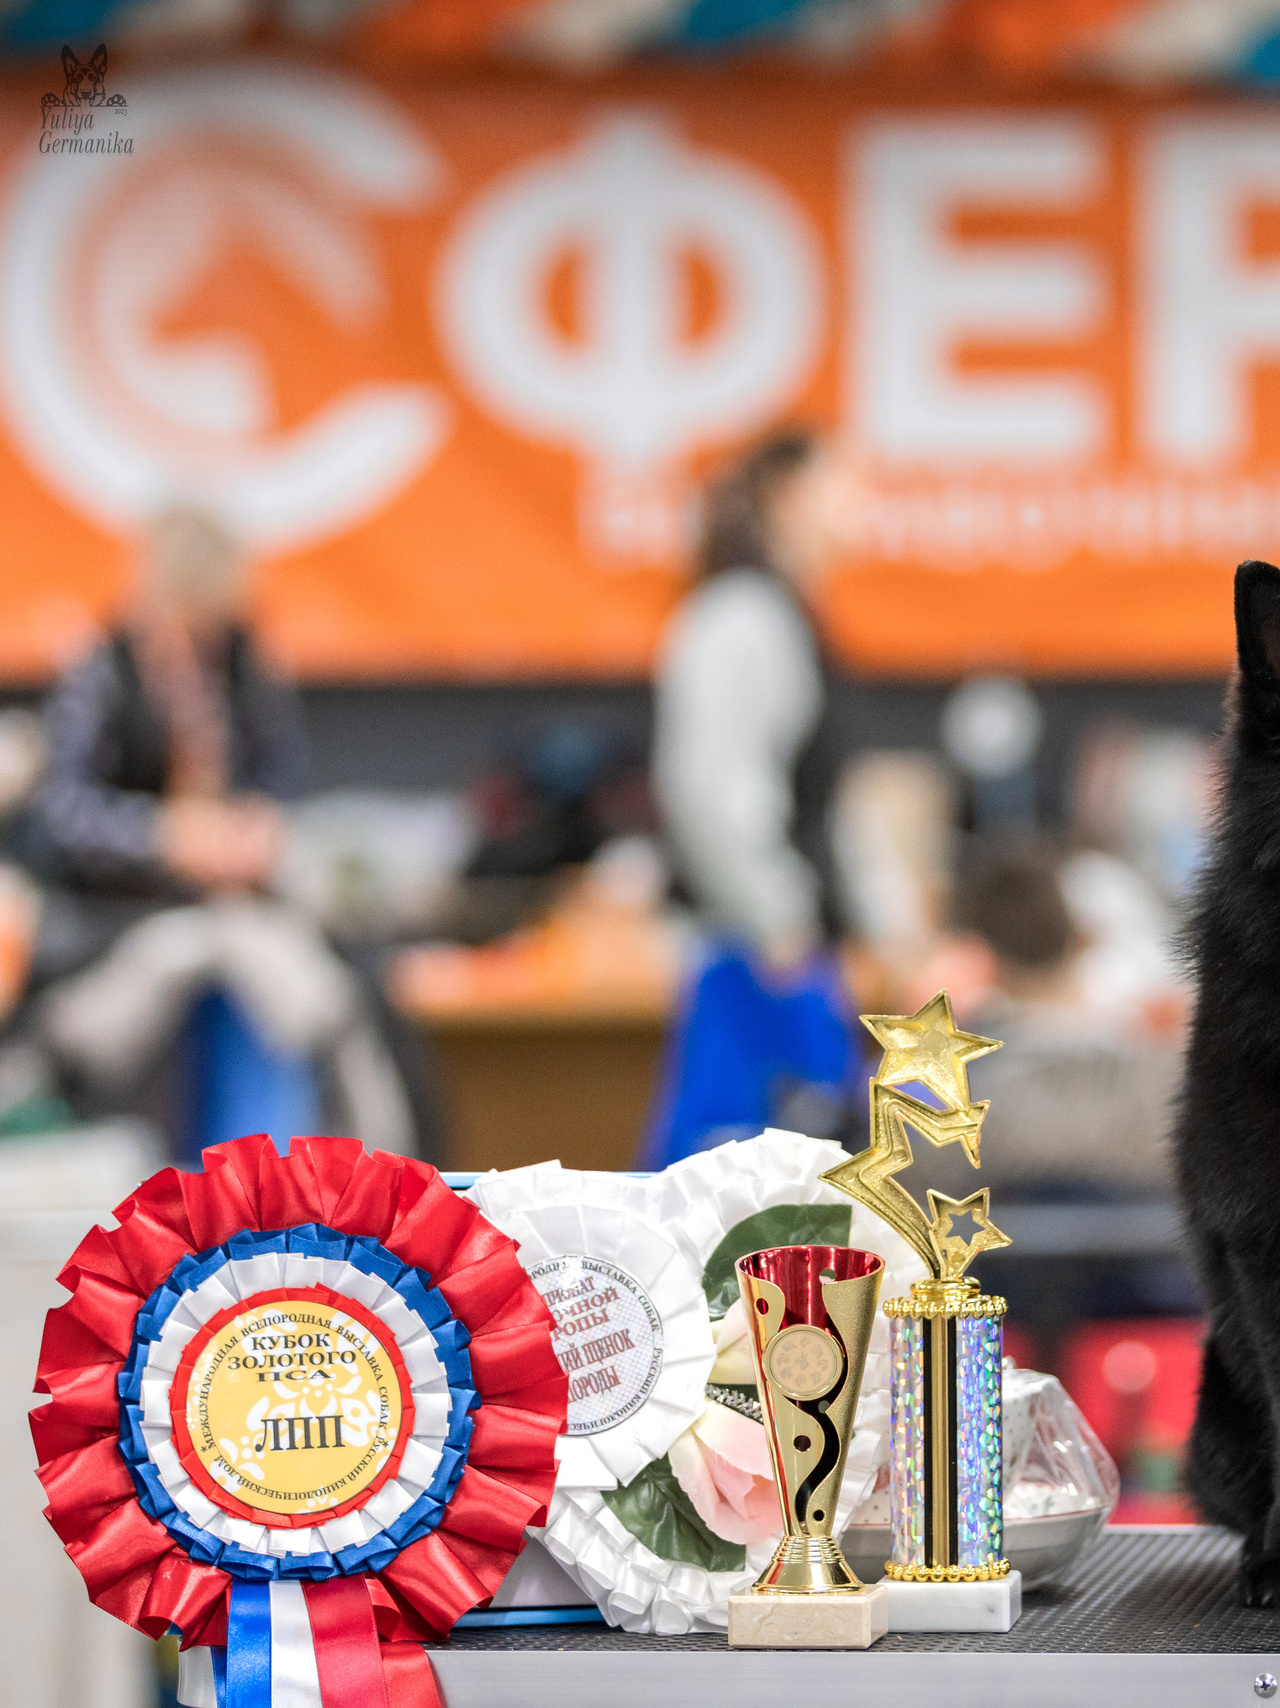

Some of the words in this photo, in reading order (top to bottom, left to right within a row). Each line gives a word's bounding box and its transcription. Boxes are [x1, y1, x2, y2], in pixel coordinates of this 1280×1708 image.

[581, 1260, 637, 1293] ВЫСТАВКА
[638, 1295, 660, 1332] СОБАК
[227, 1350, 357, 1370] ЗОЛОТОГО
[252, 1333, 330, 1351] КУБОК
[581, 1328, 636, 1365] ЩЕНОК
[199, 1336, 240, 1450] МЕЖДУНАРОДНАЯ
[241, 1313, 332, 1337] ВСЕПОРОДНАЯ
[336, 1325, 384, 1381] ВЫСТАВКА
[379, 1386, 389, 1430] СОБАК
[256, 1369, 334, 1383] ПСА
[567, 1394, 641, 1431] КИНОЛОГИЧЕС
[255, 1415, 346, 1452] ЛПП
